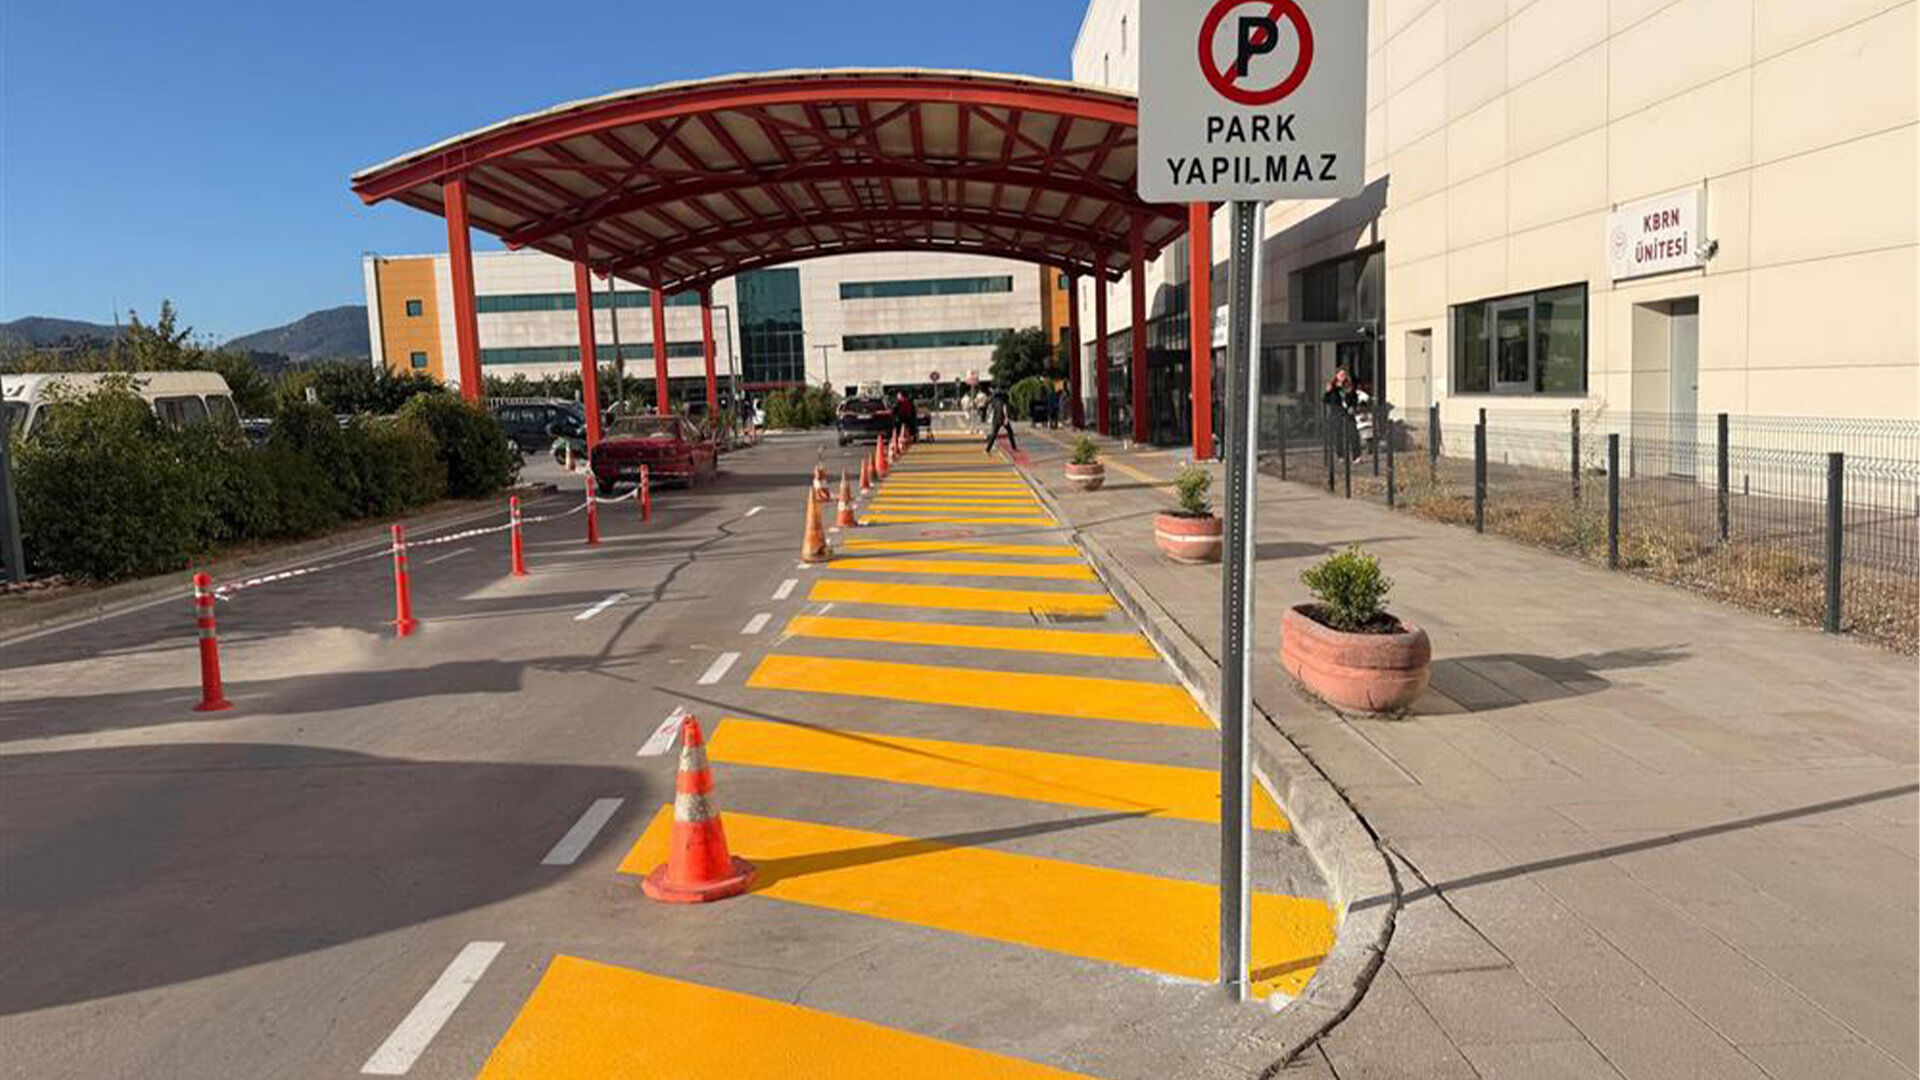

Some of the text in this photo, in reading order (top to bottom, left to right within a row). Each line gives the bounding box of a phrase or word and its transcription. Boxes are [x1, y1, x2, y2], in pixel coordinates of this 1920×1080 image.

[1237, 16, 1279, 77] P
[1207, 114, 1296, 143] PARK
[1167, 154, 1337, 185] YAPILMAZ
[1643, 208, 1680, 233] KBRN
[1635, 230, 1688, 263] ÜNİTESİ
